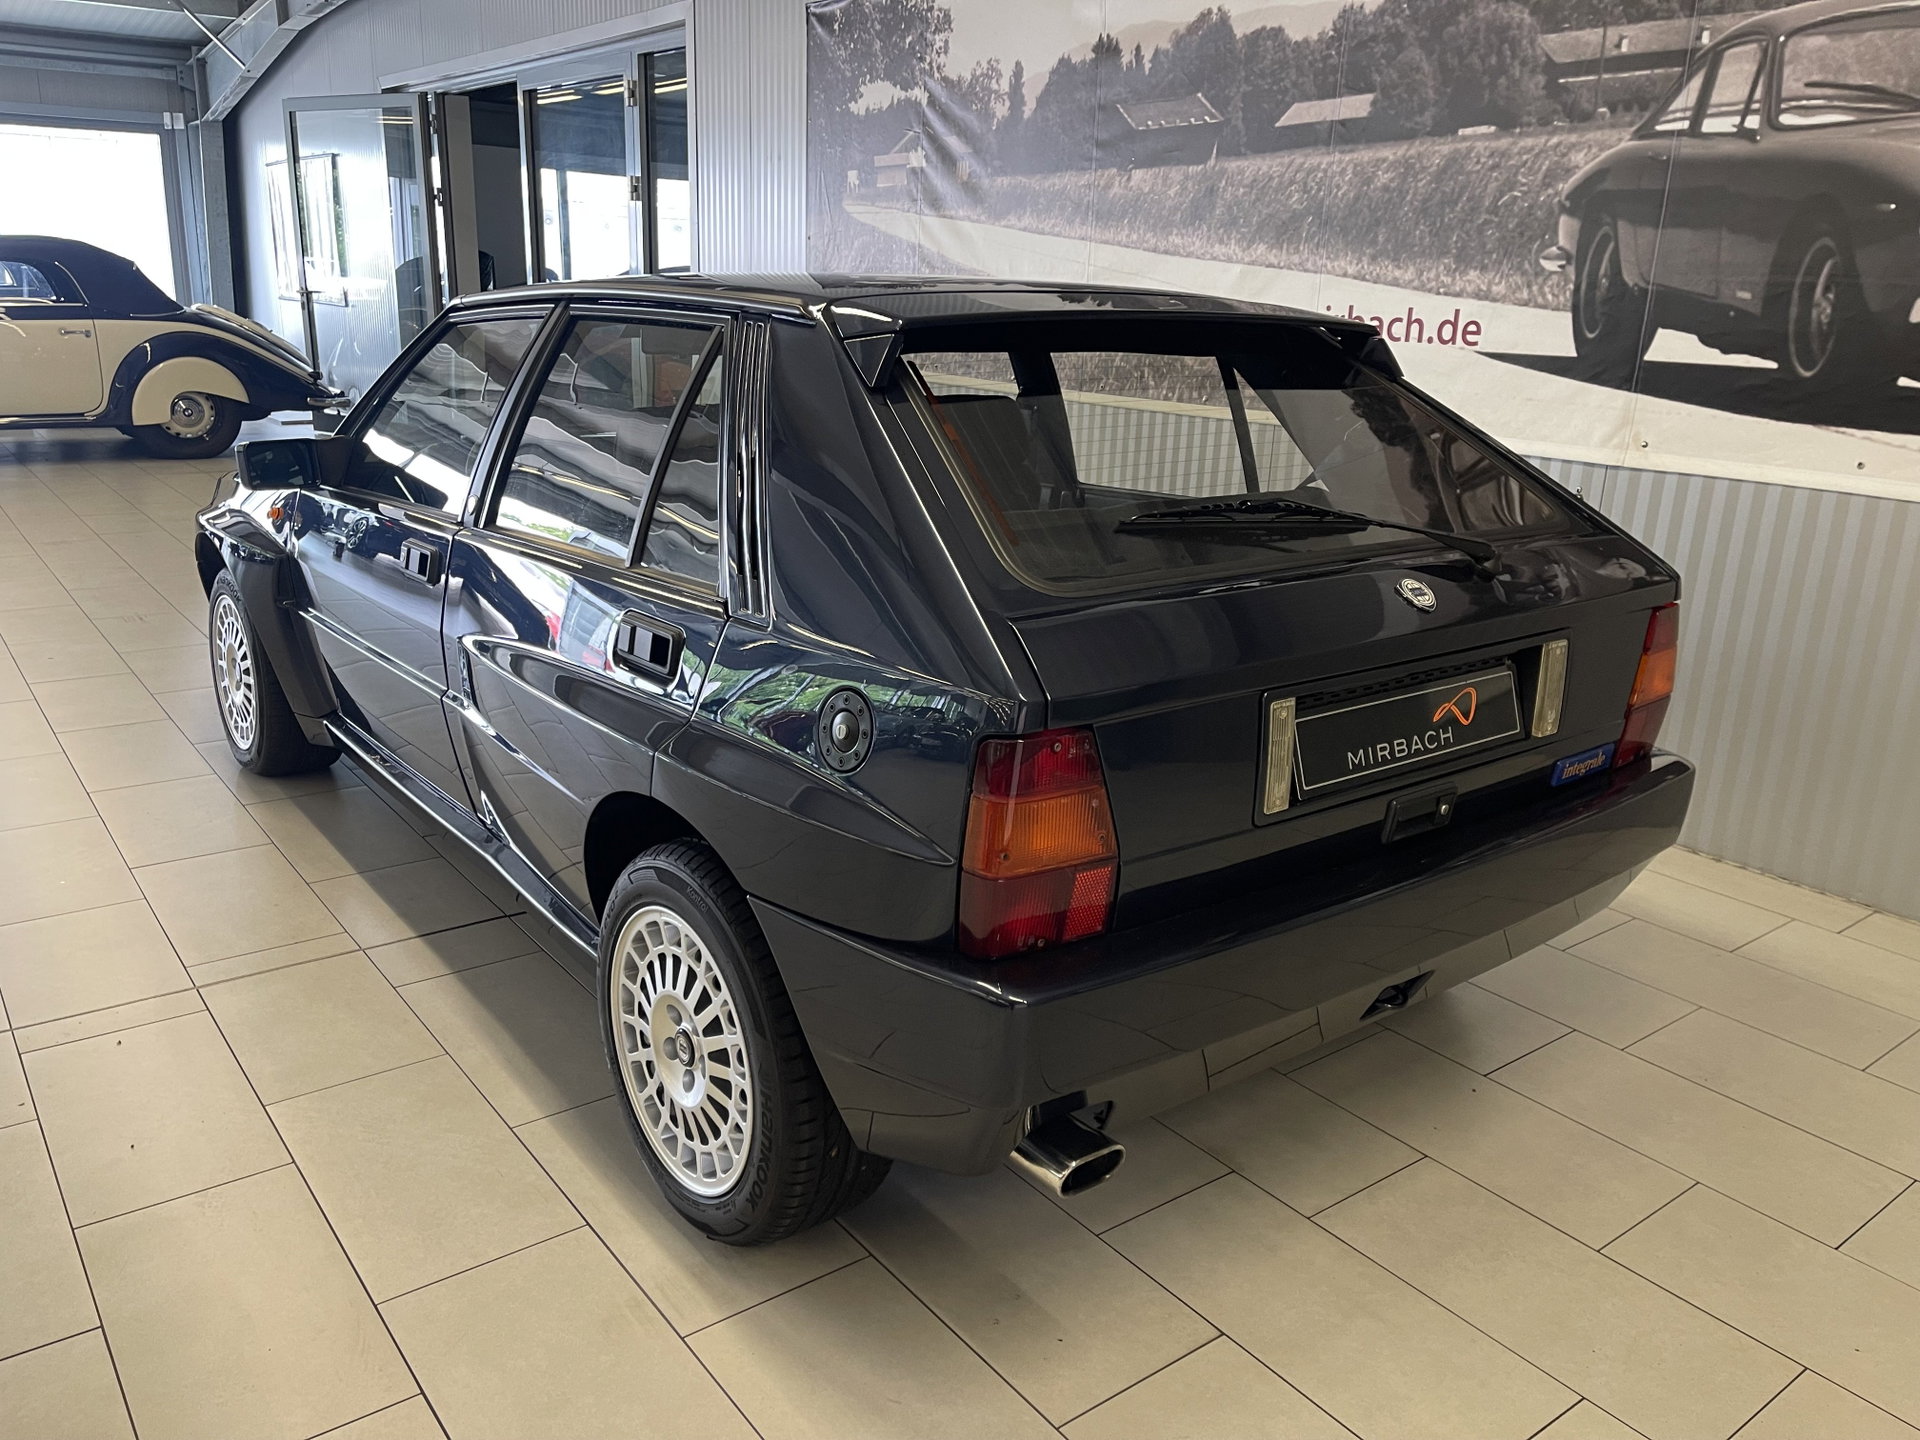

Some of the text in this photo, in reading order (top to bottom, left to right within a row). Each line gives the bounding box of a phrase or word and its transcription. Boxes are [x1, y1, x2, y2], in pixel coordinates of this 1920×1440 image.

[1326, 304, 1482, 347] ach.de
[1347, 726, 1453, 770] MIRBACH
[1562, 751, 1606, 780] integrale
